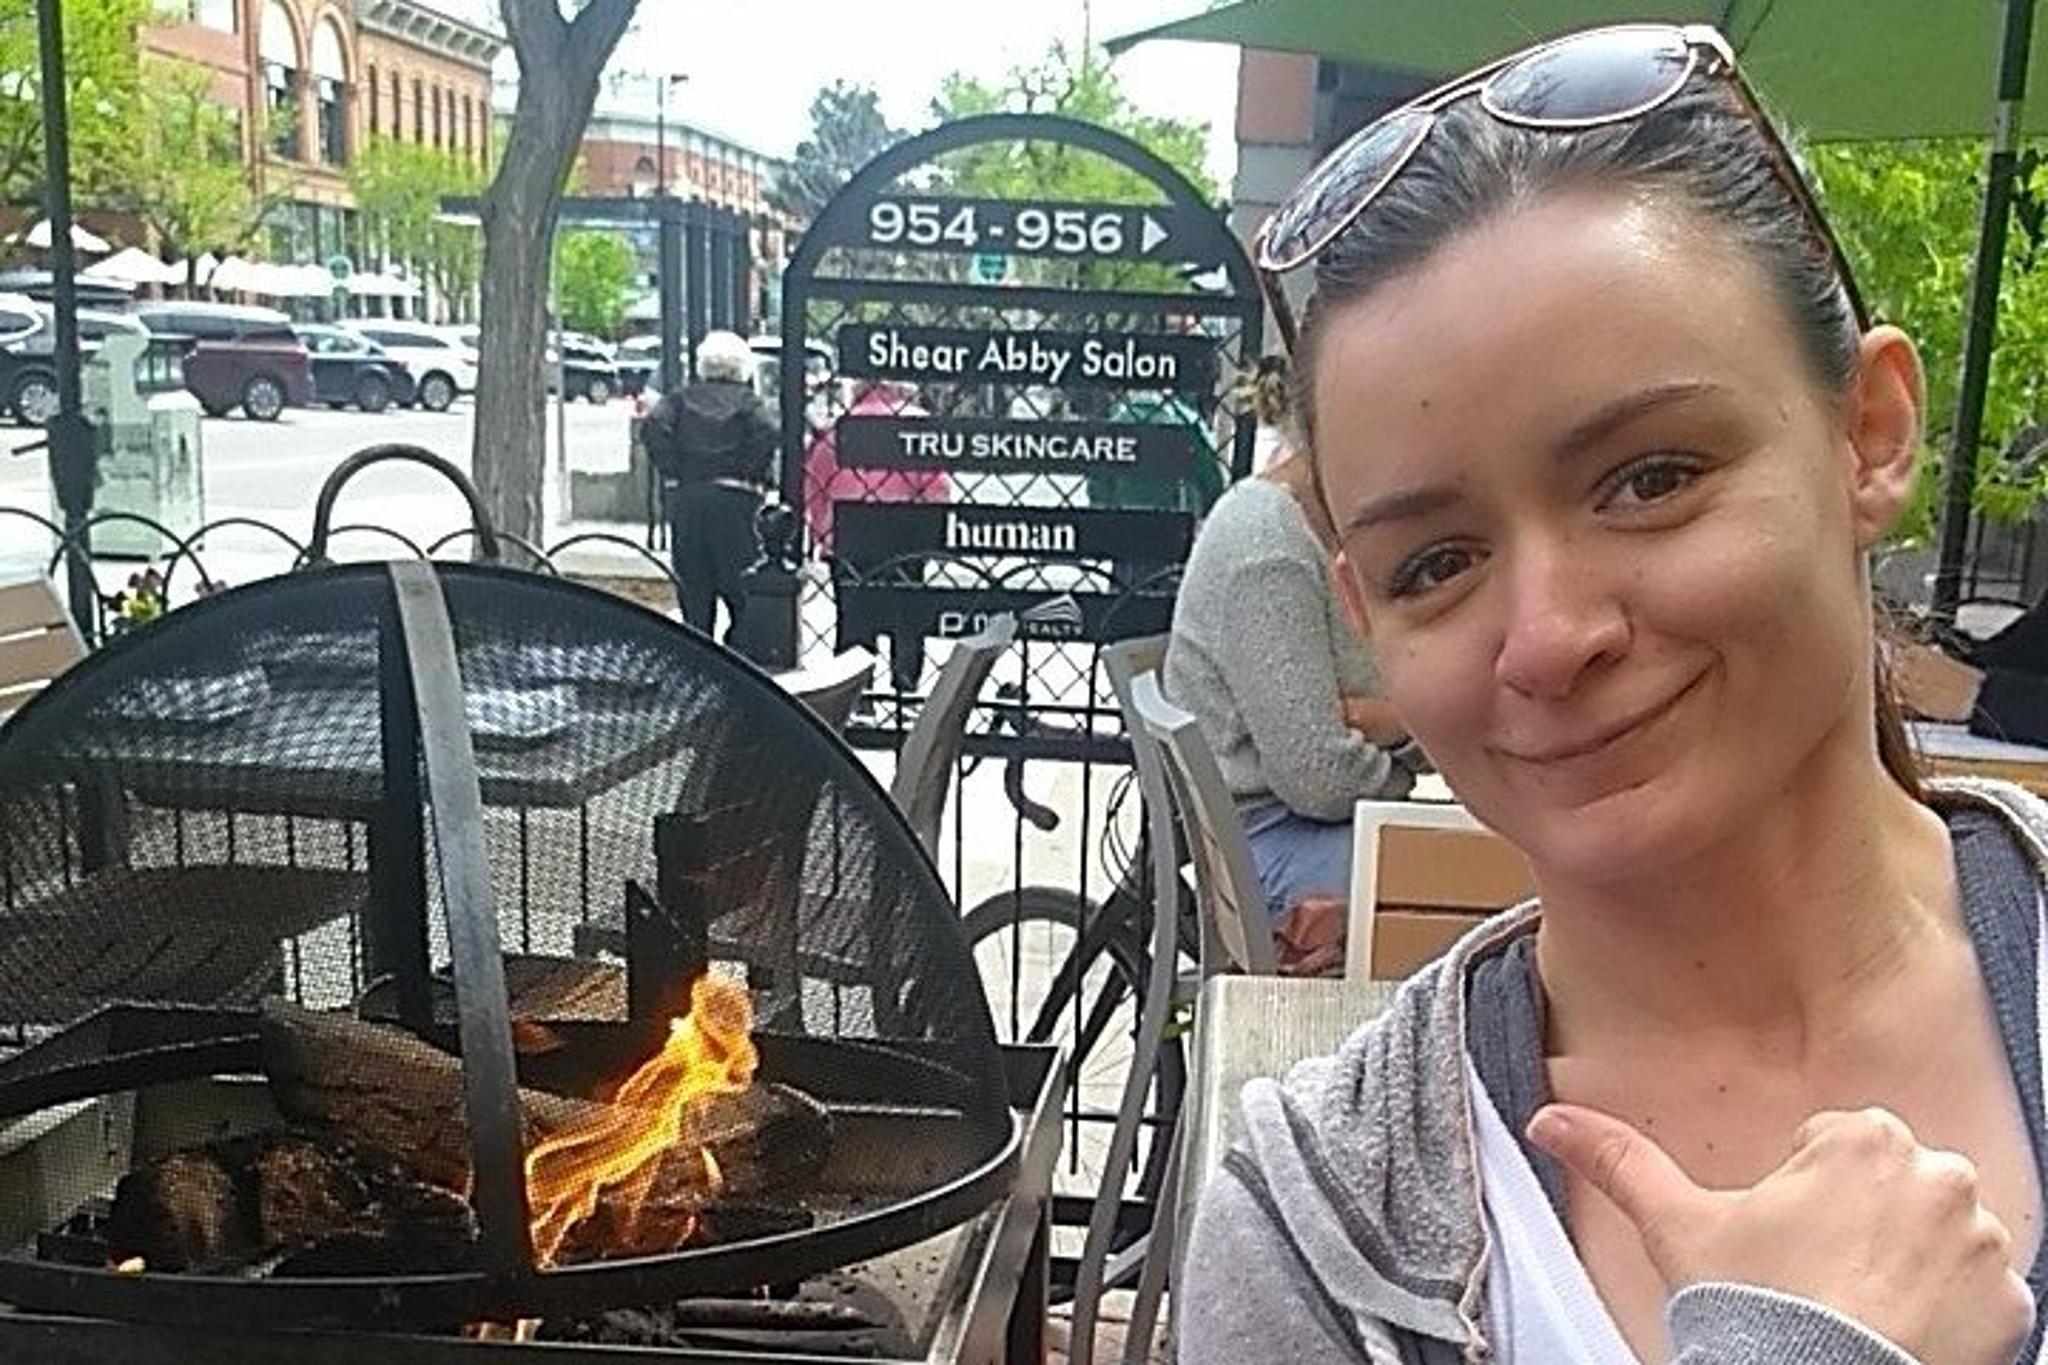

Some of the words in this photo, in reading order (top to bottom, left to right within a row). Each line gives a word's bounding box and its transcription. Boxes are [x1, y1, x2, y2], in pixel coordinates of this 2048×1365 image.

[868, 331, 970, 371] Shear
[978, 340, 1071, 383] Abby
[1081, 342, 1177, 379] Salon
[901, 431, 964, 458] TRU
[970, 436, 1137, 462] SKINCARE
[946, 512, 1077, 552] human
